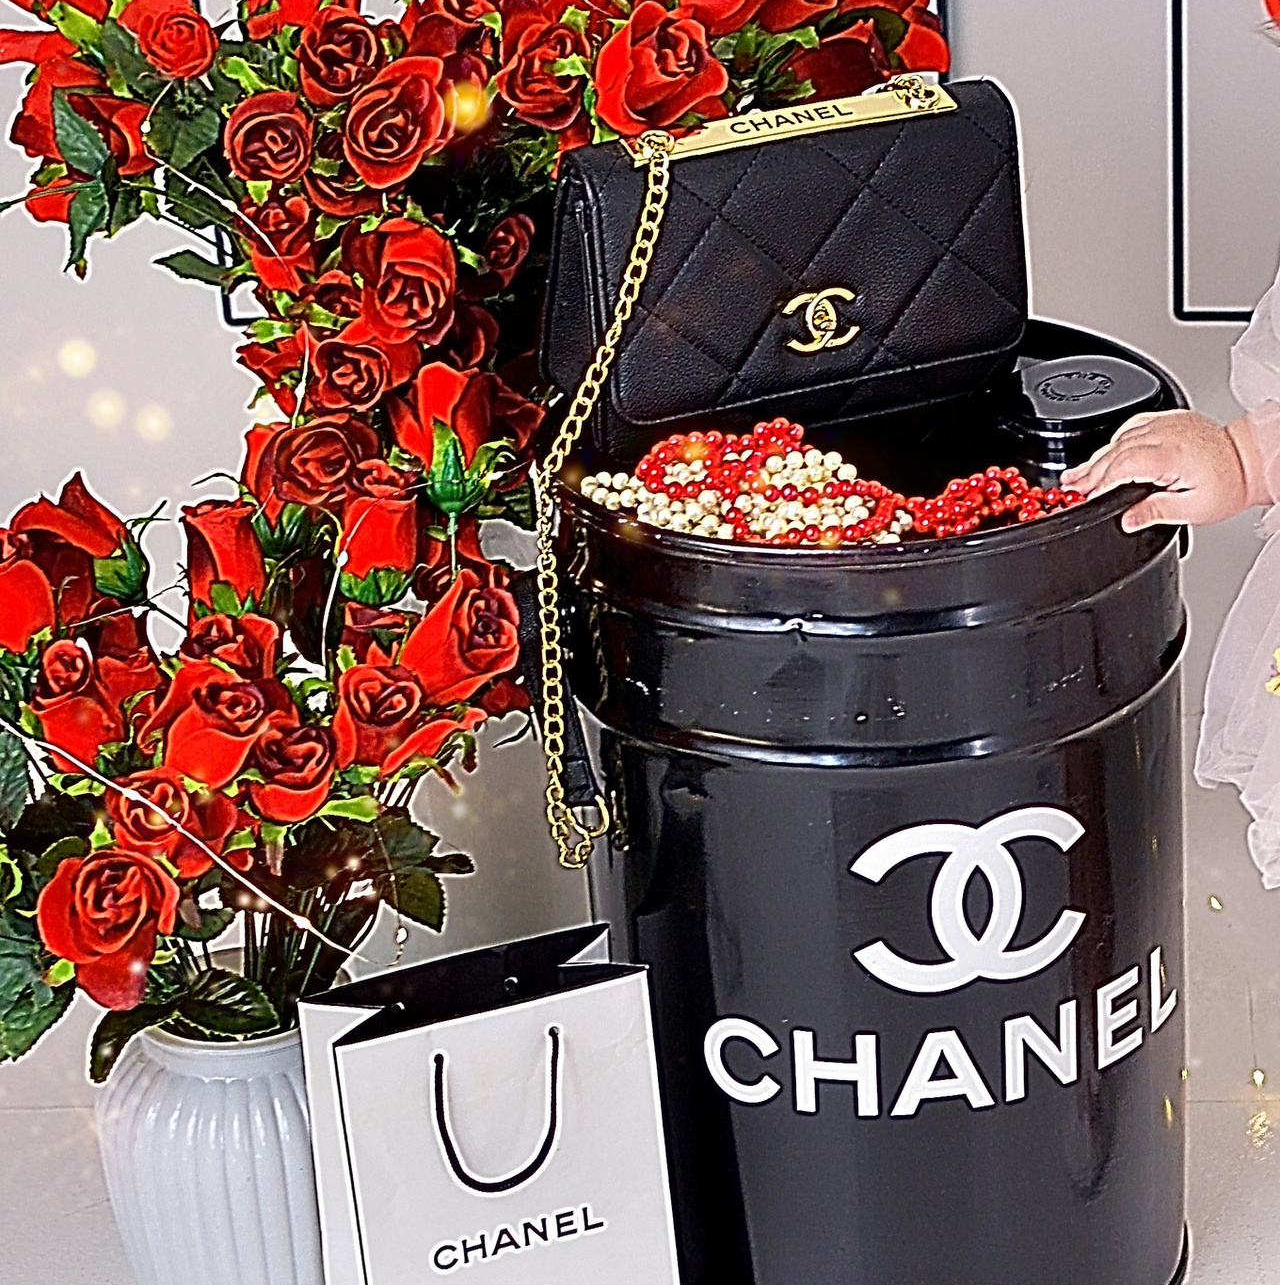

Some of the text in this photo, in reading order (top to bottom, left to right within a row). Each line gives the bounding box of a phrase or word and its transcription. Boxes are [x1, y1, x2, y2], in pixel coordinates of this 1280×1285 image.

[729, 104, 854, 134] CHANEL
[702, 946, 1178, 1117] CHANEL
[433, 1206, 605, 1270] CHANEL
